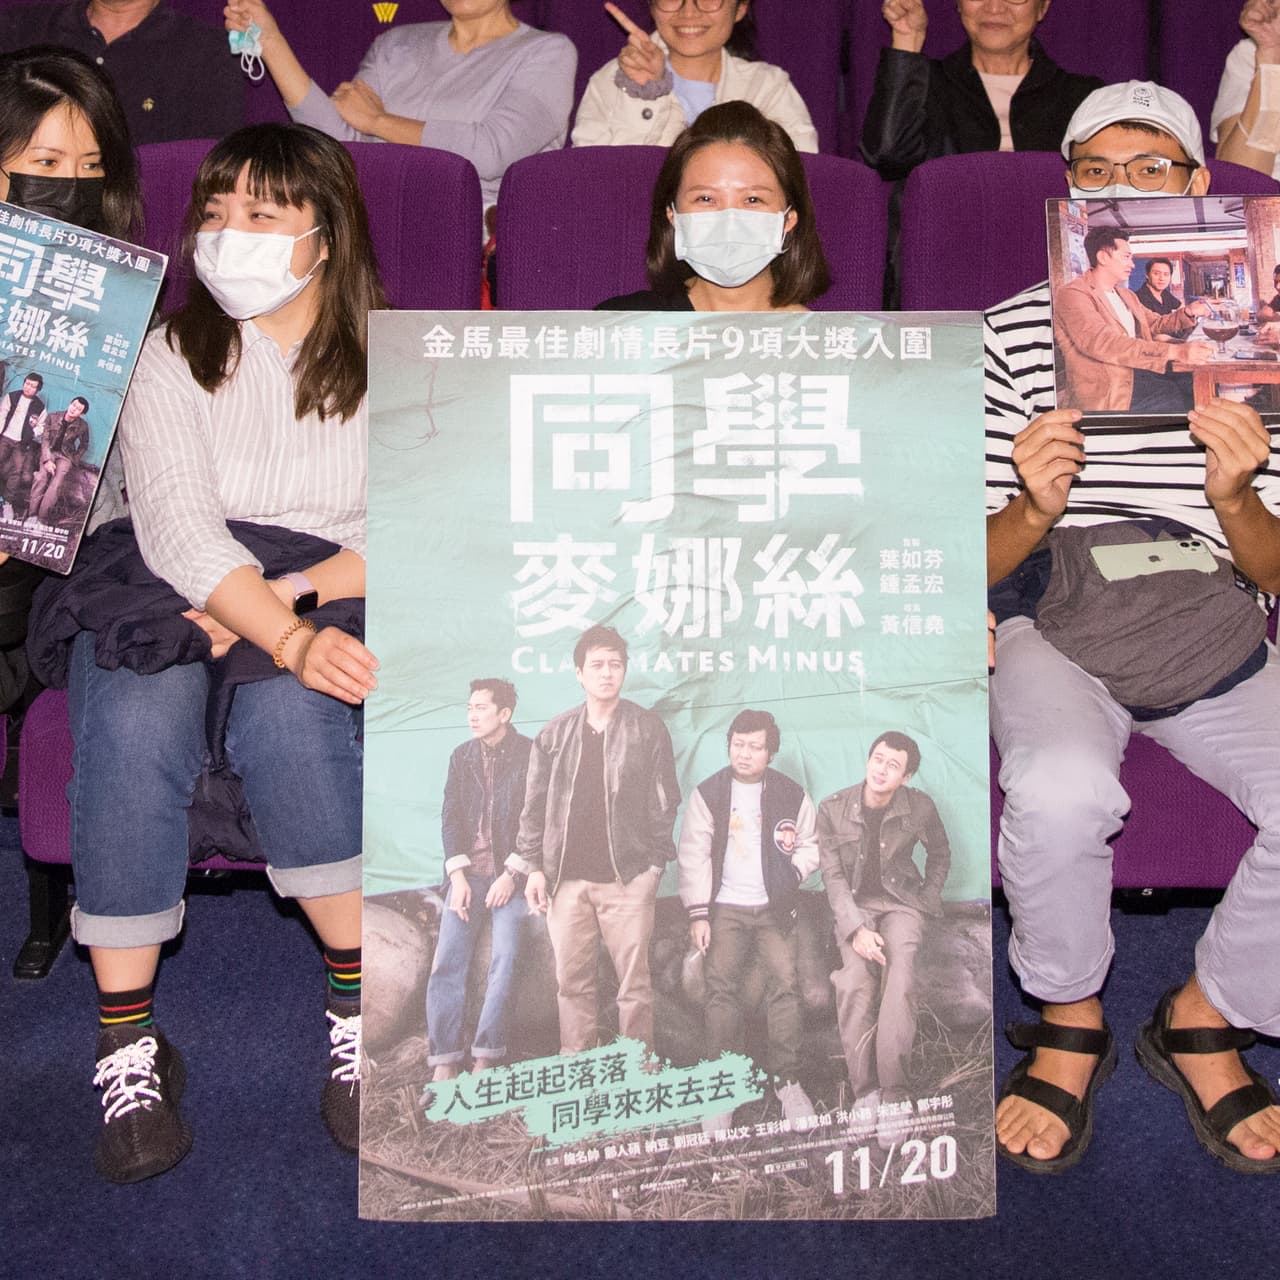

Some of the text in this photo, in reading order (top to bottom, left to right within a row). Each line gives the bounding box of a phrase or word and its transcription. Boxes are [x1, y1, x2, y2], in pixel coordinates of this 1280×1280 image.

[422, 325, 932, 360] 金馬最佳劇情長片9項大獎入圍
[510, 372, 865, 523] 同學
[20, 537, 66, 560] 11/20
[879, 549, 944, 570] 葉如芬
[511, 533, 865, 638] 麥娜絲
[748, 645, 865, 674] MINUS
[444, 1051, 628, 1115] 人生起起落落
[550, 1069, 737, 1134] 同學來來去去
[825, 1134, 957, 1195] 11/20
